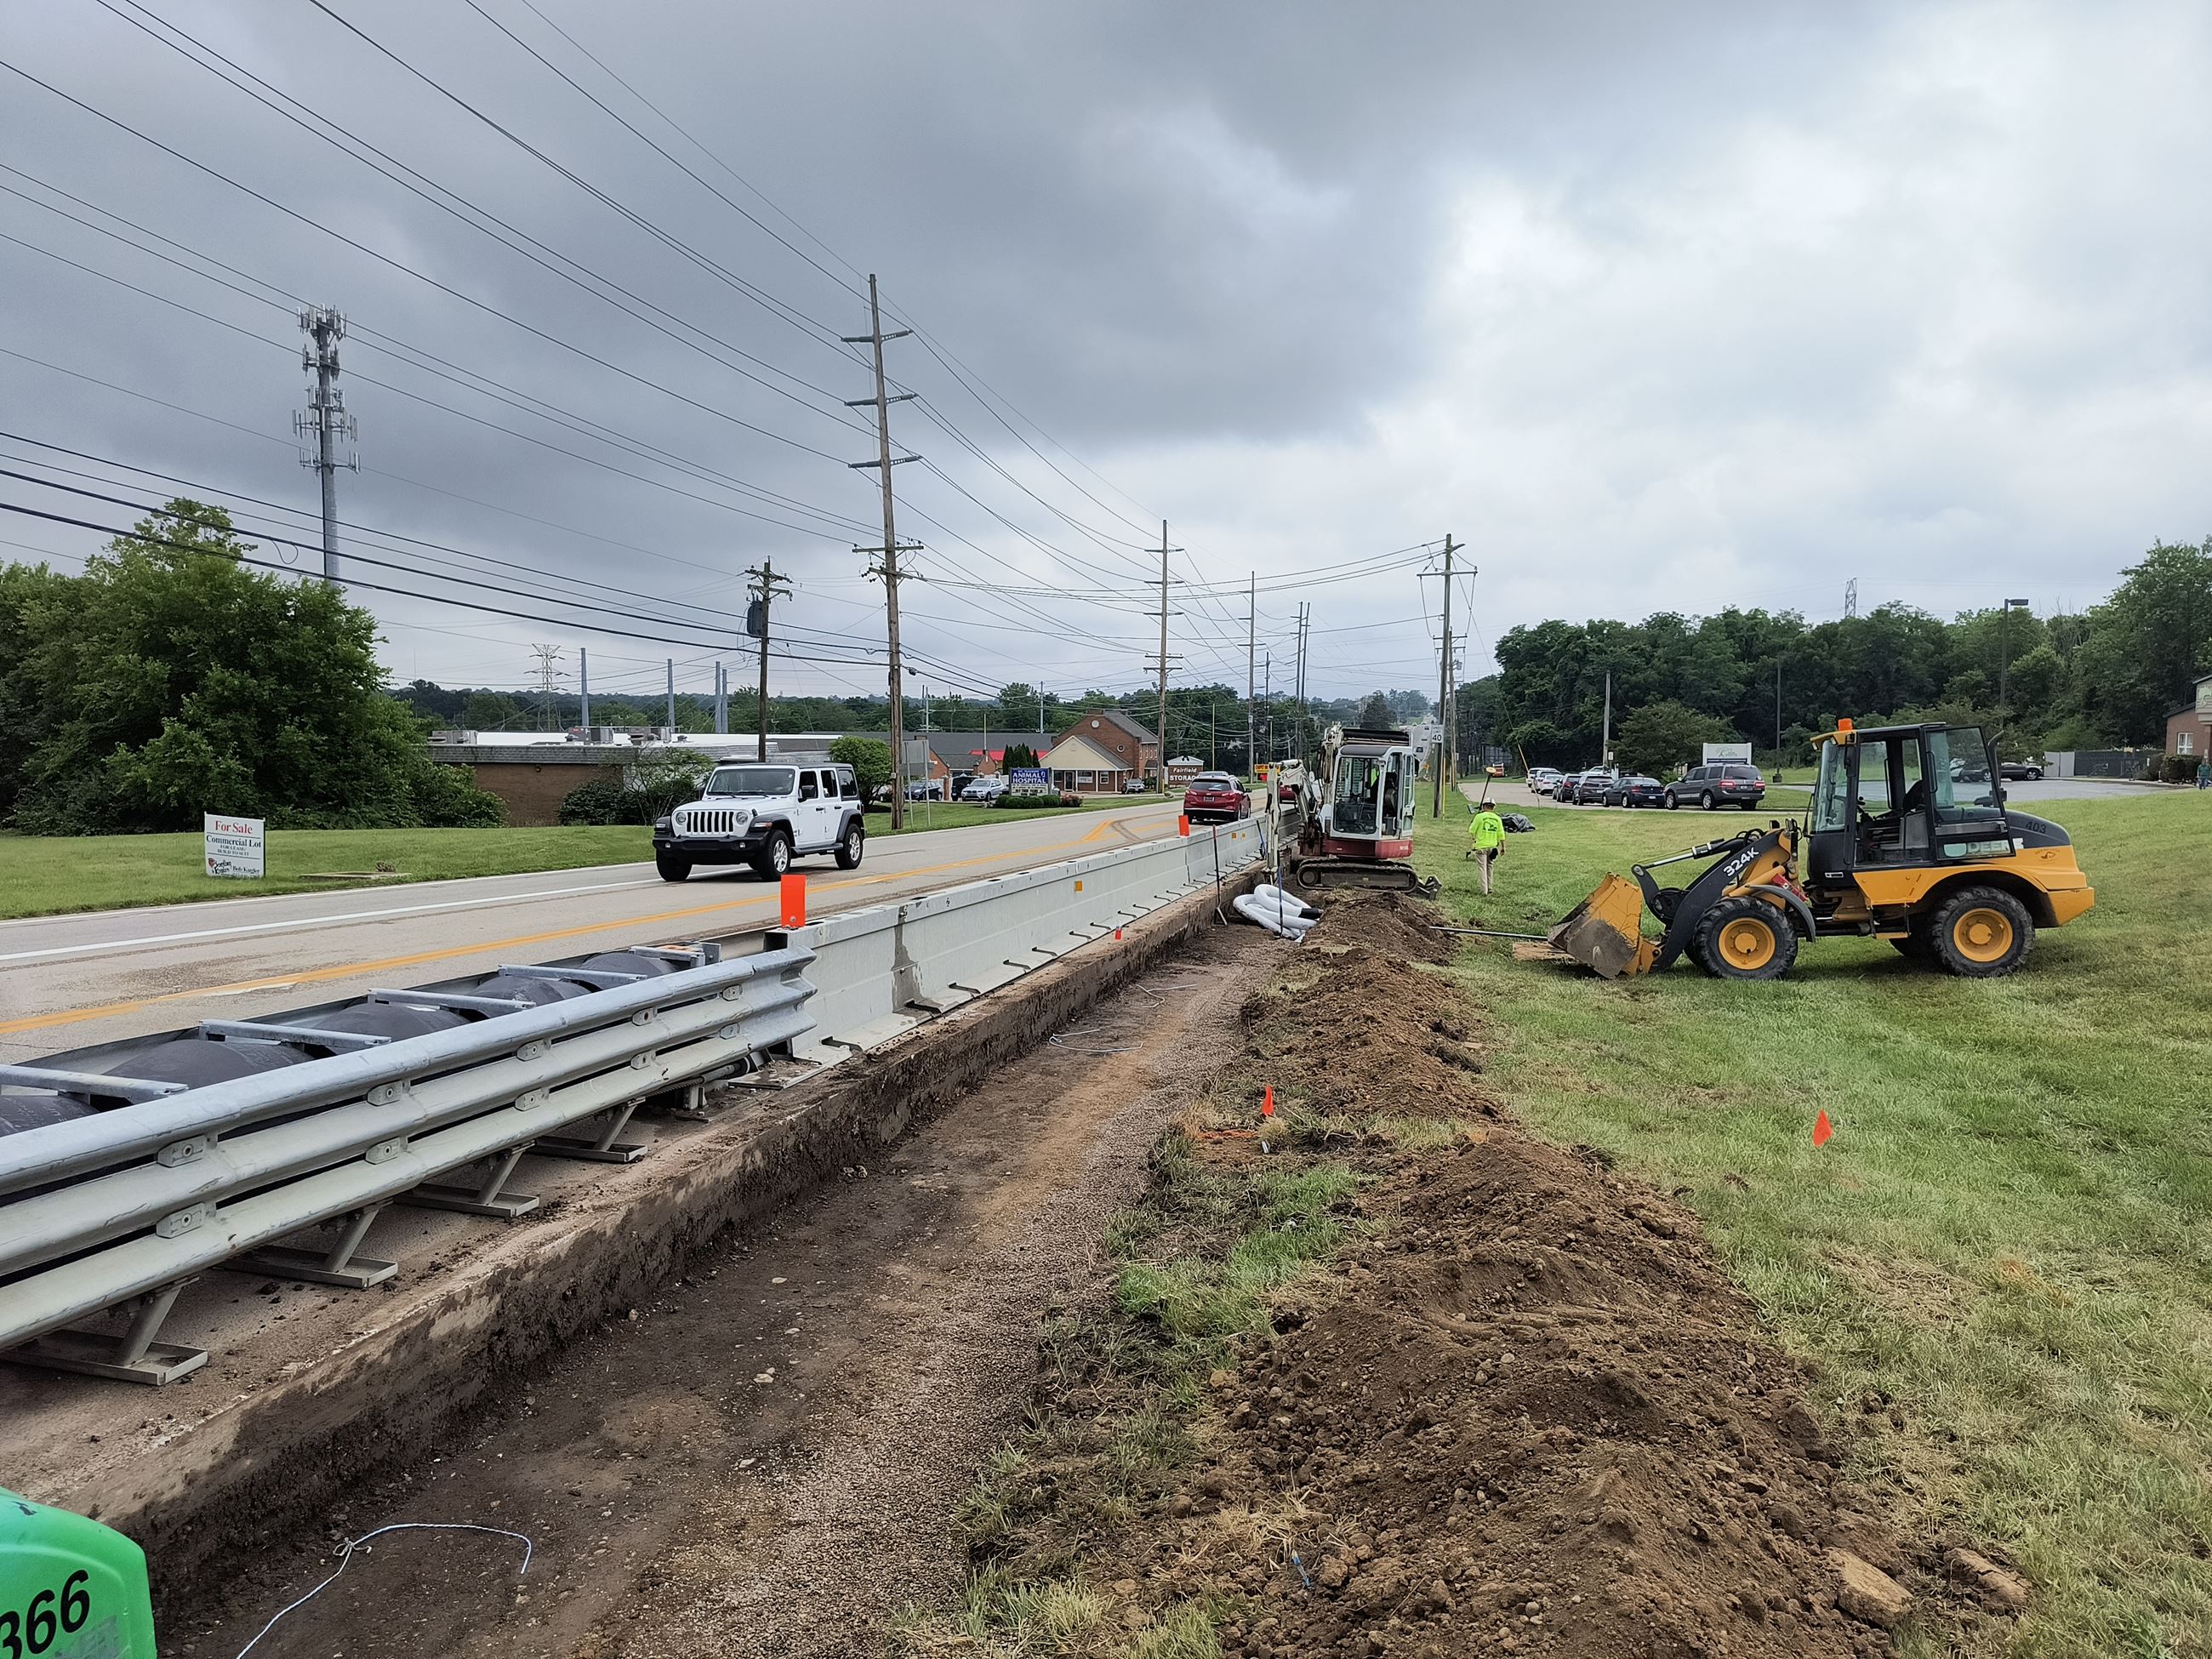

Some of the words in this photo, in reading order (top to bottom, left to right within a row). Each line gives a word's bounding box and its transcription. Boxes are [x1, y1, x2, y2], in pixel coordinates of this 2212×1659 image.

[215, 820, 231, 832] For
[232, 822, 253, 834] Sale
[2026, 821, 2047, 834] 403
[206, 835, 248, 847] Commercial
[249, 839, 262, 848] Lot
[1723, 847, 1759, 876] 324K
[0, 1570, 89, 1659] 366
